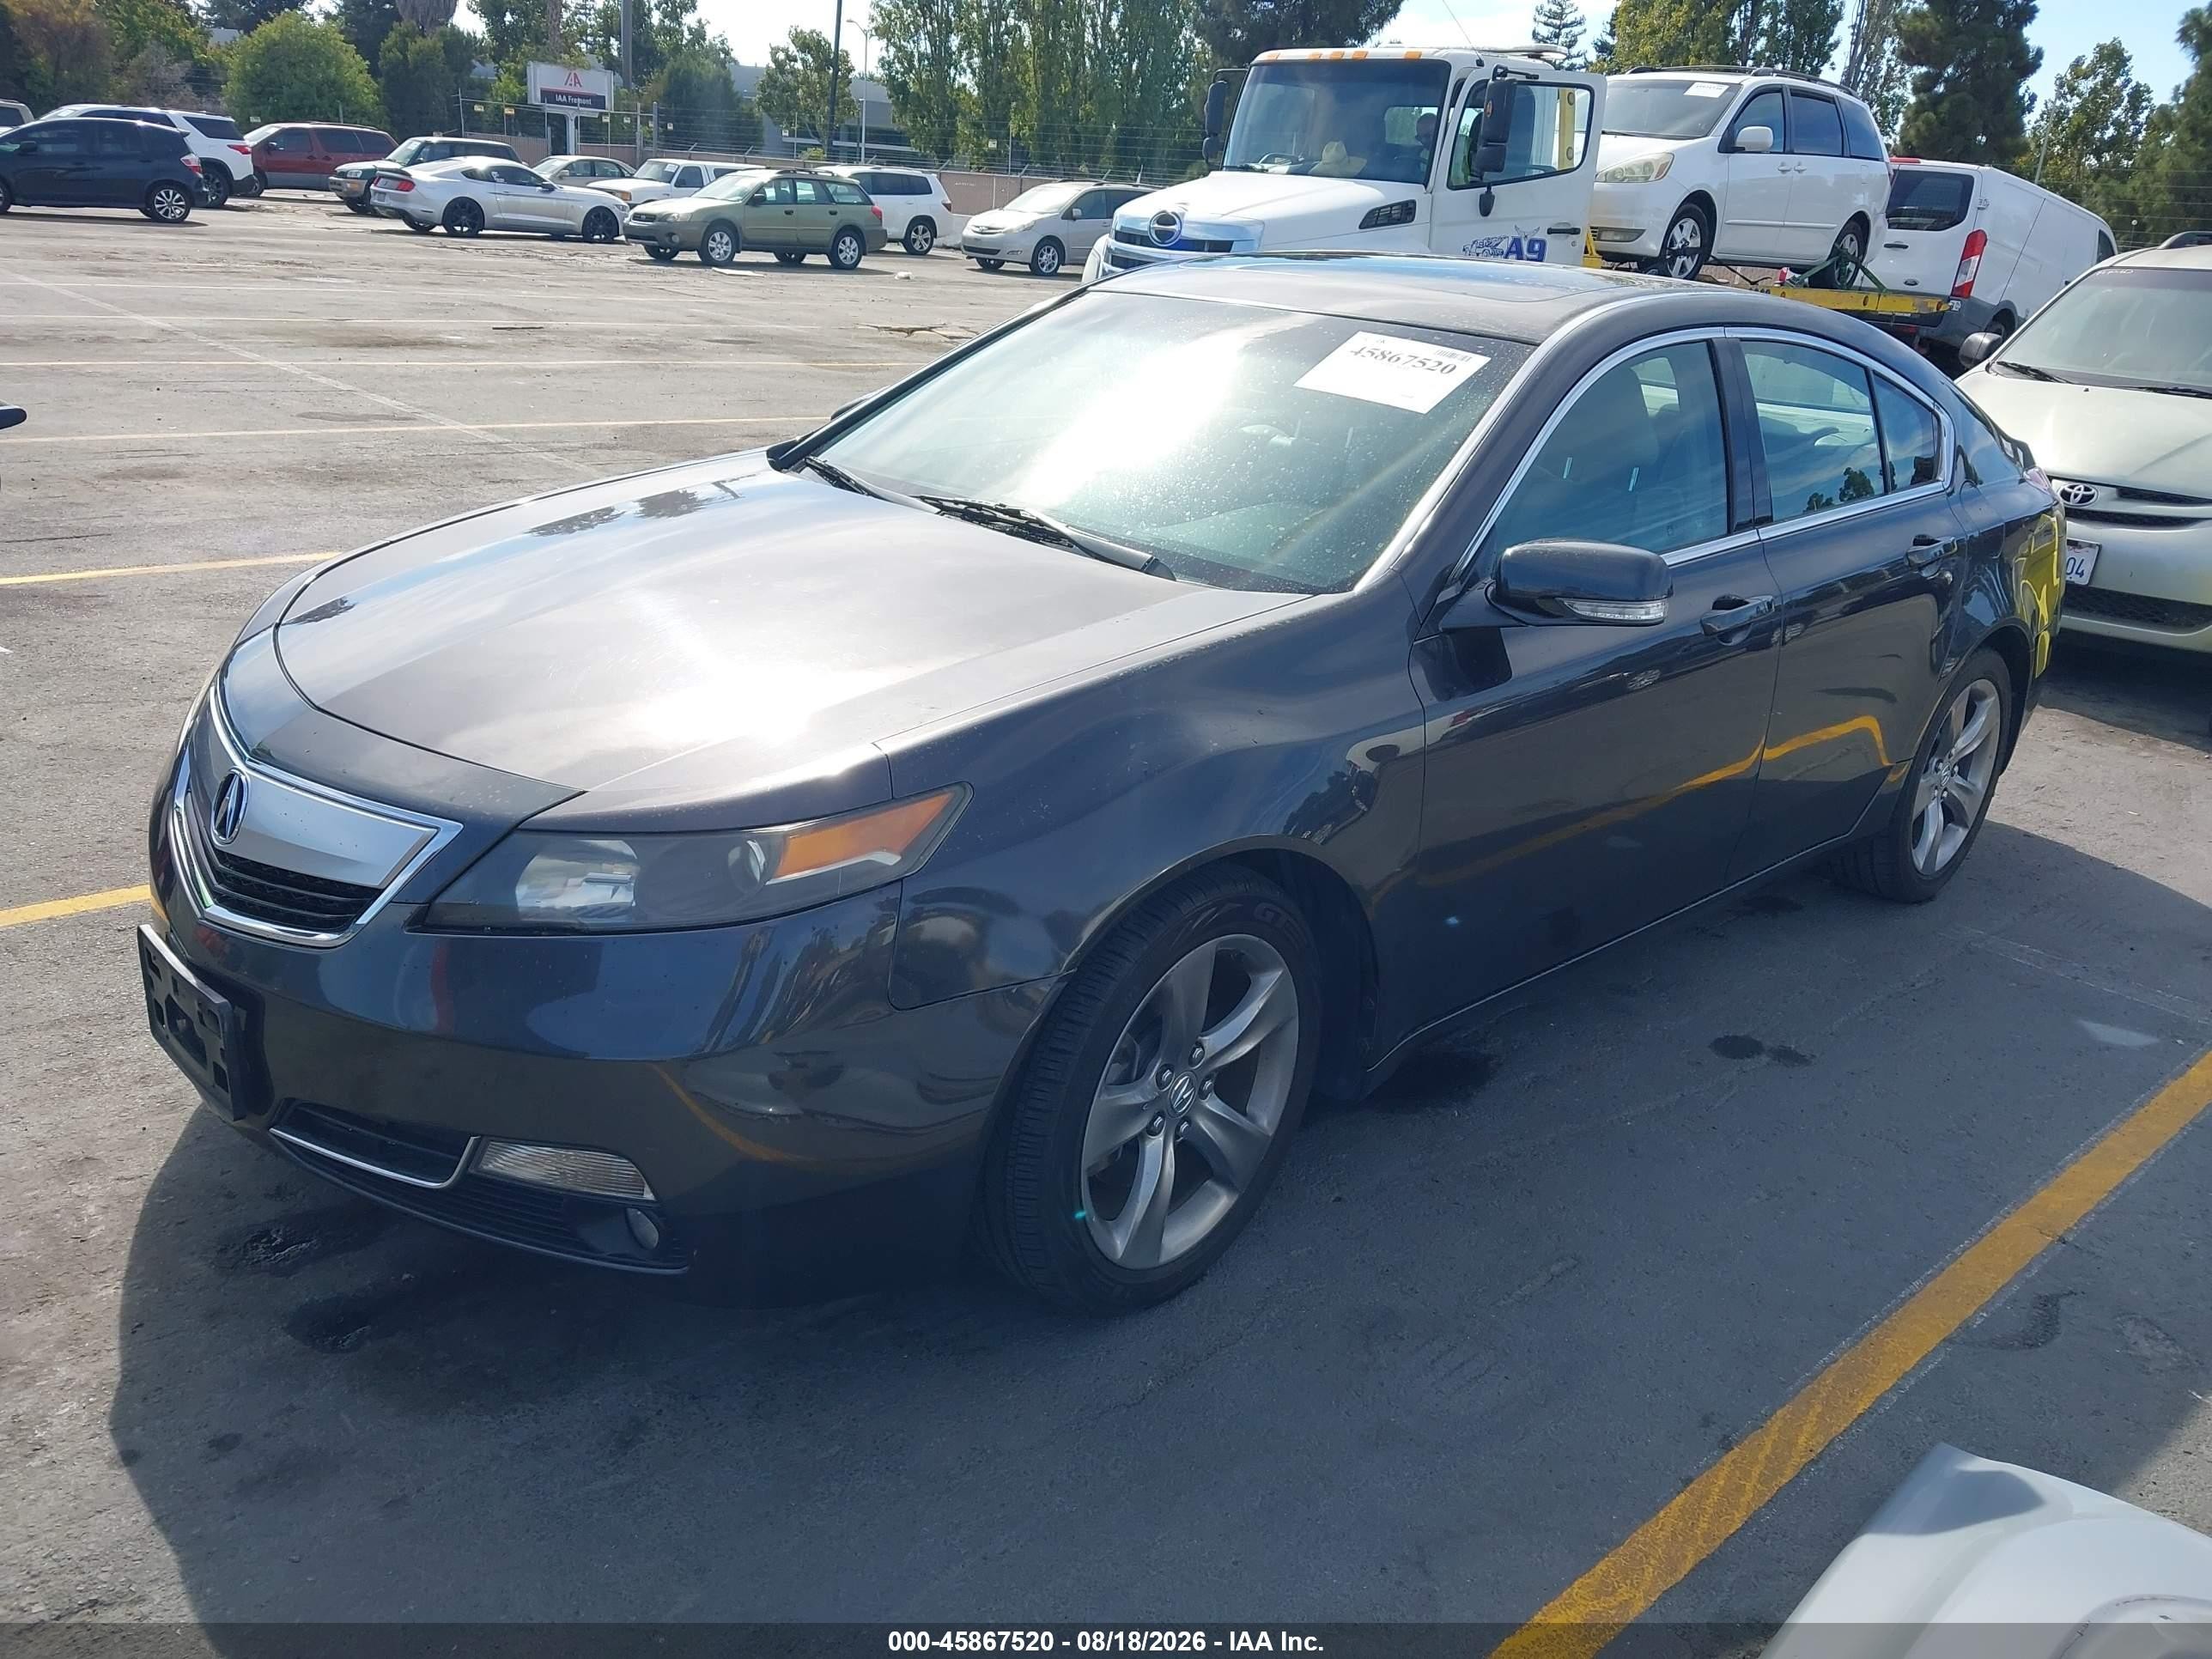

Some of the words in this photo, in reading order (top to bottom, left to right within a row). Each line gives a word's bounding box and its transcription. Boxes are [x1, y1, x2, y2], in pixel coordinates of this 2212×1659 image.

[555, 94, 568, 103] IAA
[568, 95, 592, 105] Fremont
[1504, 236, 1547, 262] A9
[1349, 345, 1458, 374] 45867520
